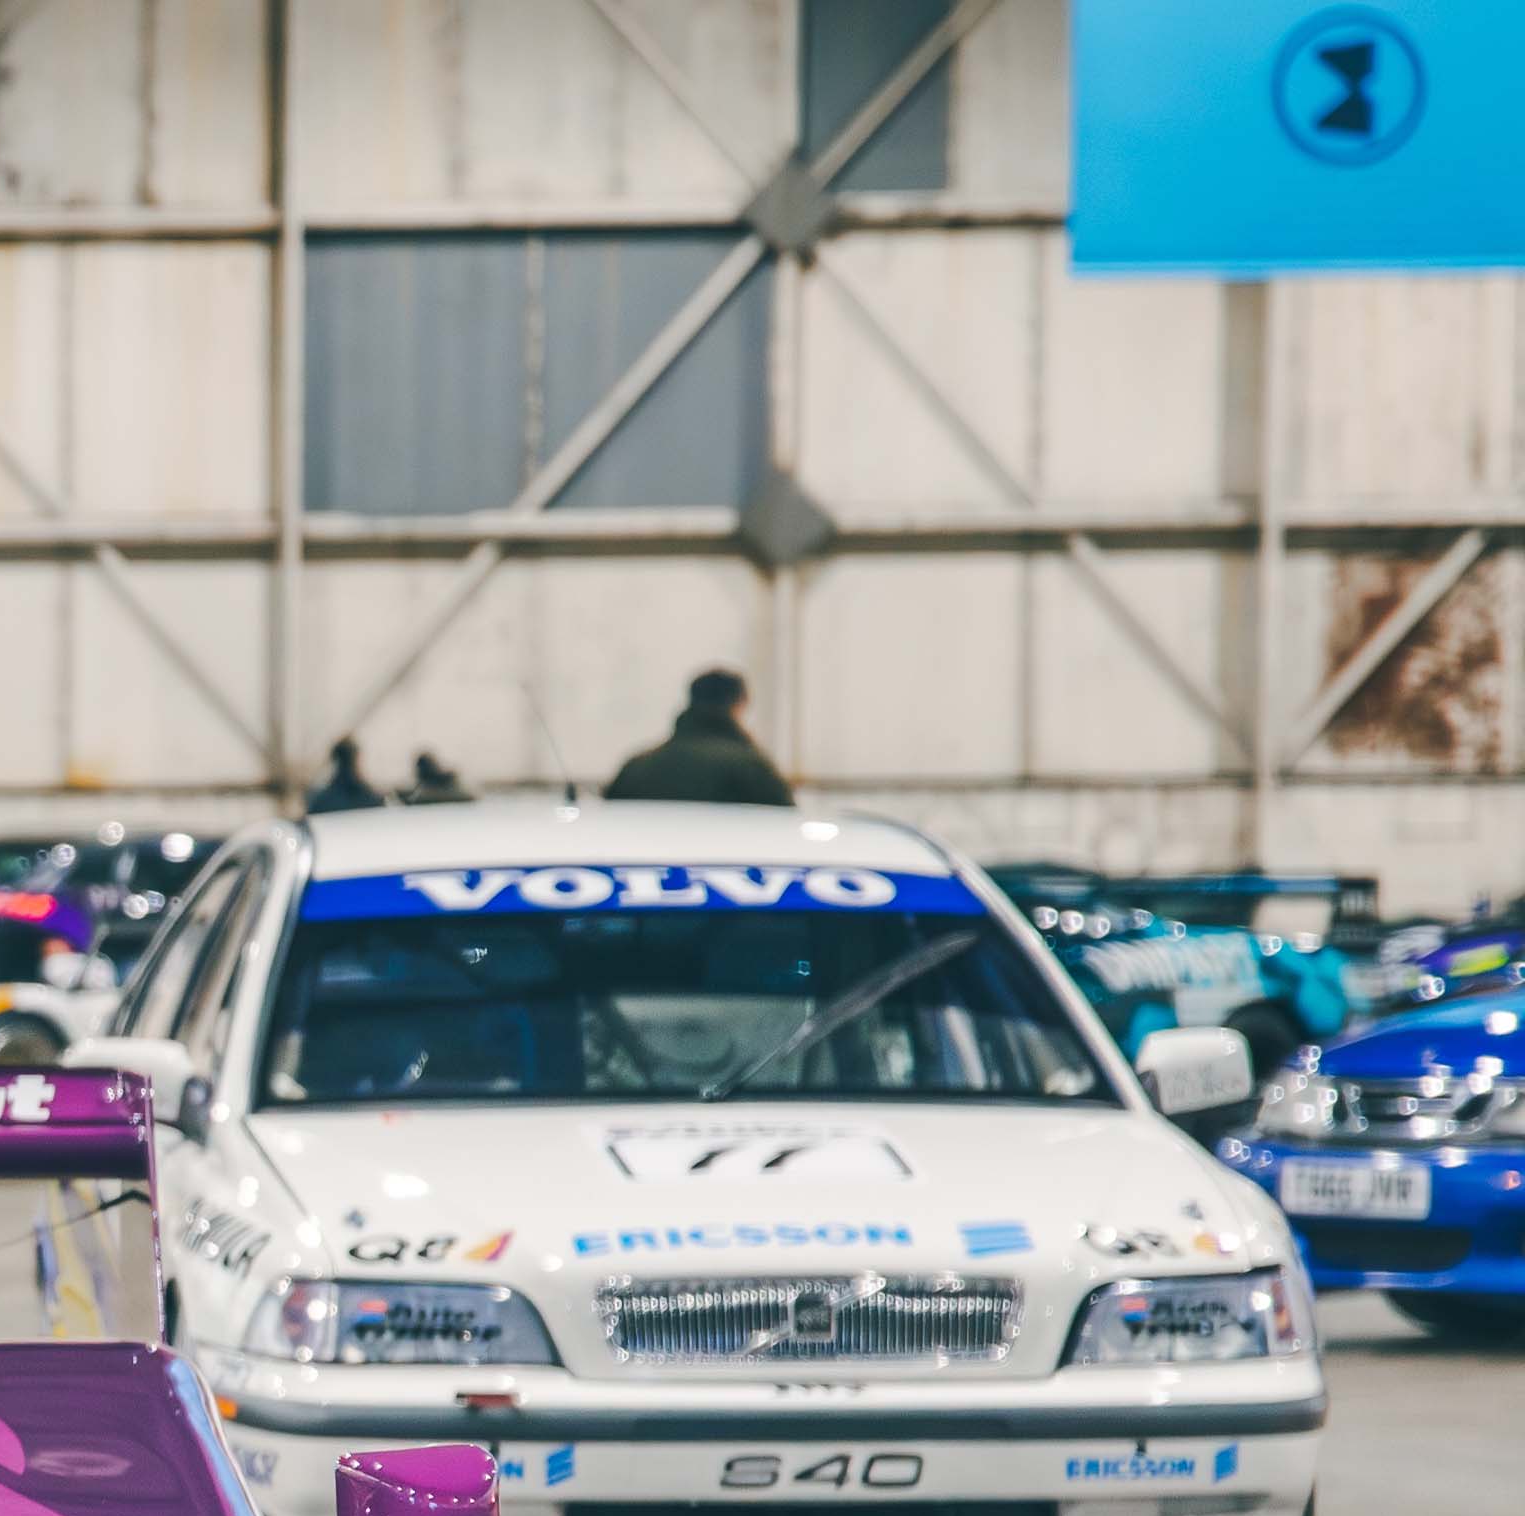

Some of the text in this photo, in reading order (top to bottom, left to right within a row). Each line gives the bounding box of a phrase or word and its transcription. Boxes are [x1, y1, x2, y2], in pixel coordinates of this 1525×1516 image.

[402, 866, 898, 911] VOLVO
[571, 1221, 914, 1258] ERICSSON
[719, 1451, 924, 1491] S40
[1065, 1456, 1197, 1482] ERICSSON
